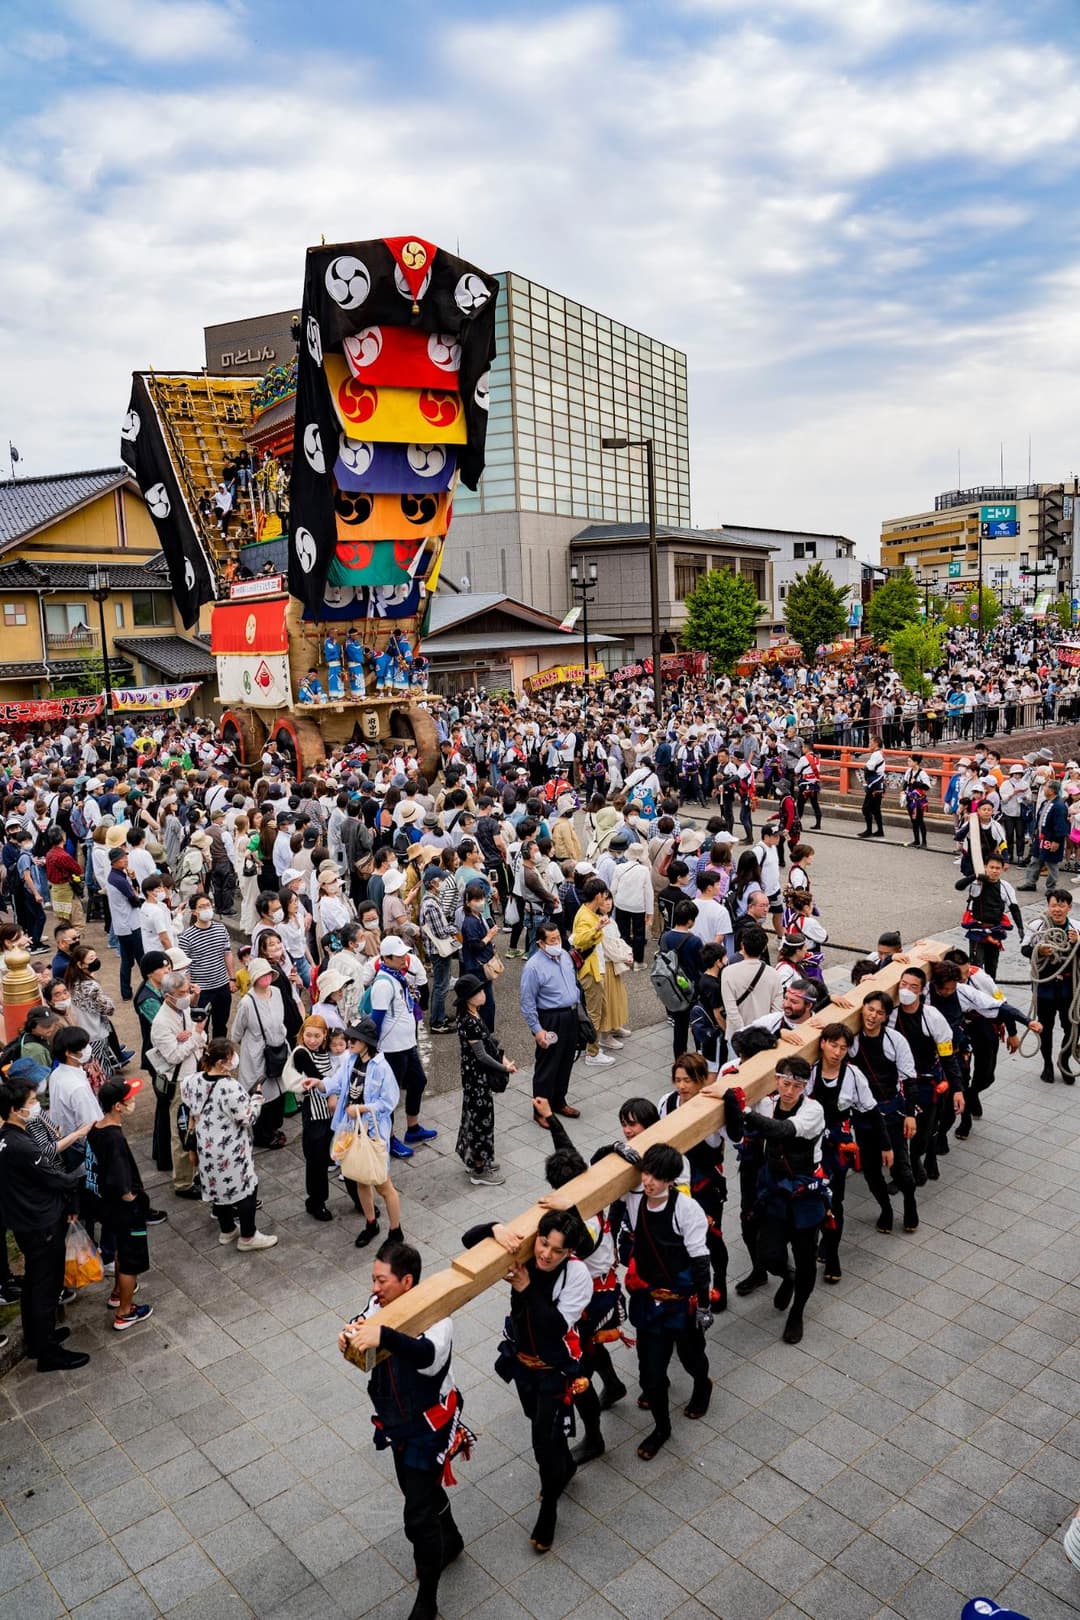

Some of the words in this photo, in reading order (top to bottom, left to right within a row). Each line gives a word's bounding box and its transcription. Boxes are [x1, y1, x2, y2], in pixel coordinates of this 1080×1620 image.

[222, 346, 274, 366] のとしん
[987, 508, 1010, 519] ニトリ
